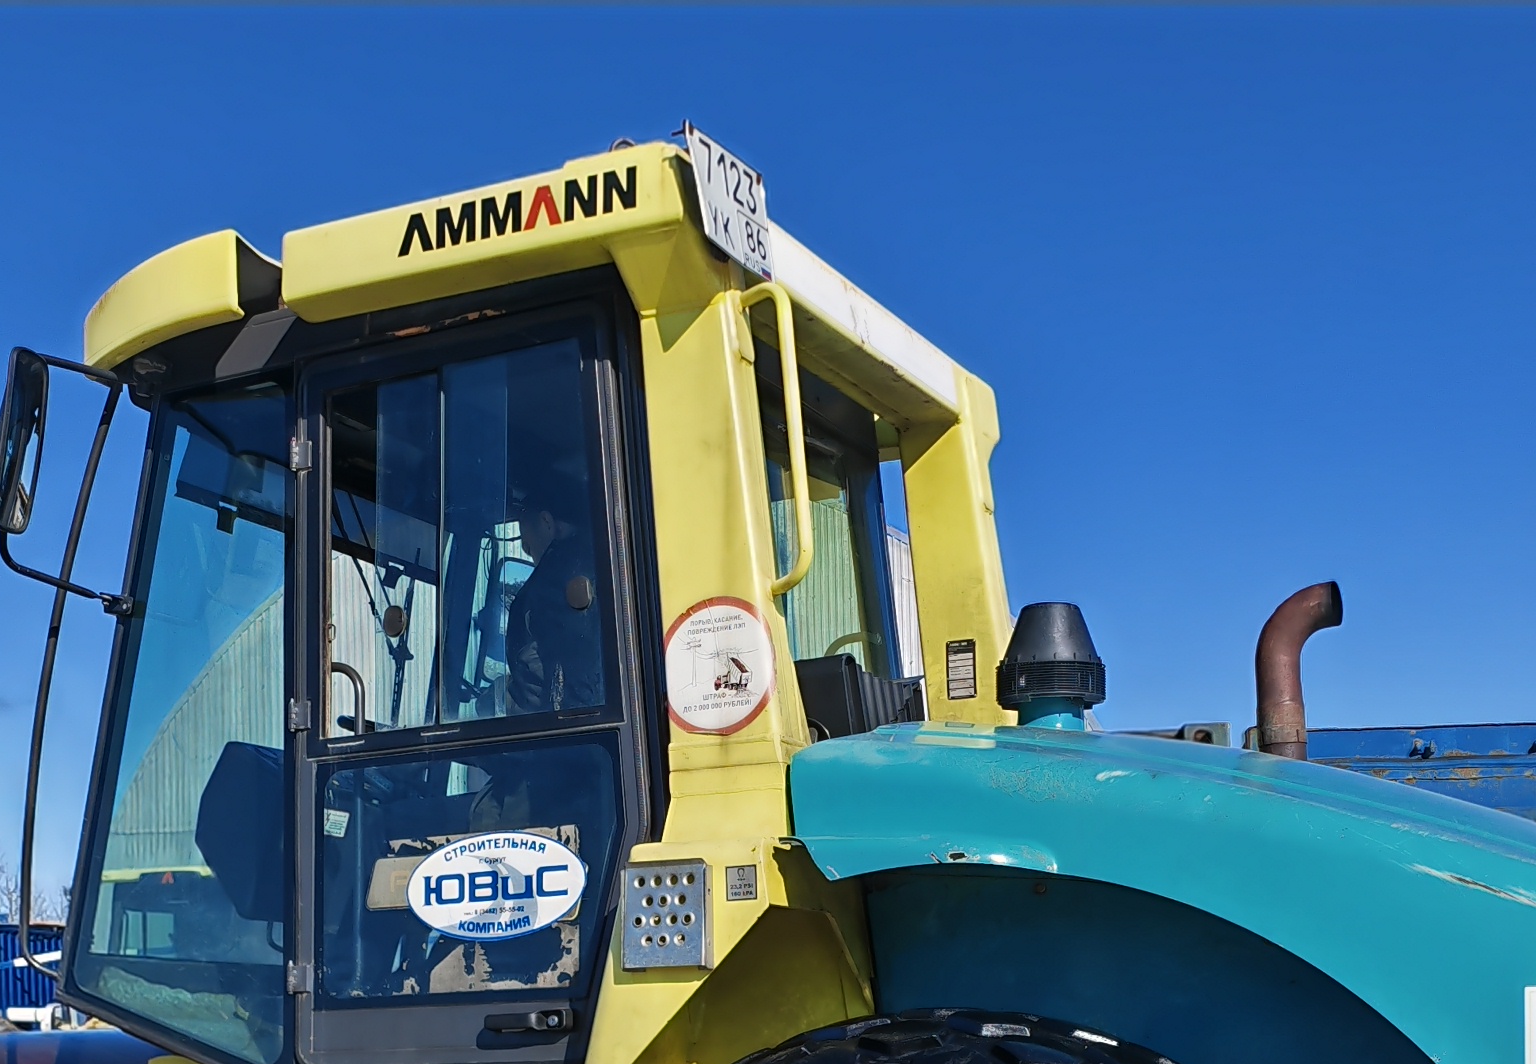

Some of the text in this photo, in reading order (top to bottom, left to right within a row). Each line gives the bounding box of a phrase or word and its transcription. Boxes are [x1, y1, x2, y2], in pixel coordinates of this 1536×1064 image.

[699, 137, 757, 215] 7123
[398, 166, 637, 257] AMMANN
[745, 221, 767, 261] 86
[744, 252, 761, 273] RUS
[687, 622, 746, 636] ПОВРЕЖДЕНИЕ ЛЭП
[683, 706, 692, 714] ДО
[723, 699, 752, 708] РУБЛЕЙ!
[703, 692, 726, 701] ШТРАФ
[444, 837, 546, 862] СТРОИТЕЛЬНАЯ
[458, 915, 531, 934] КОМПАНИЯ
